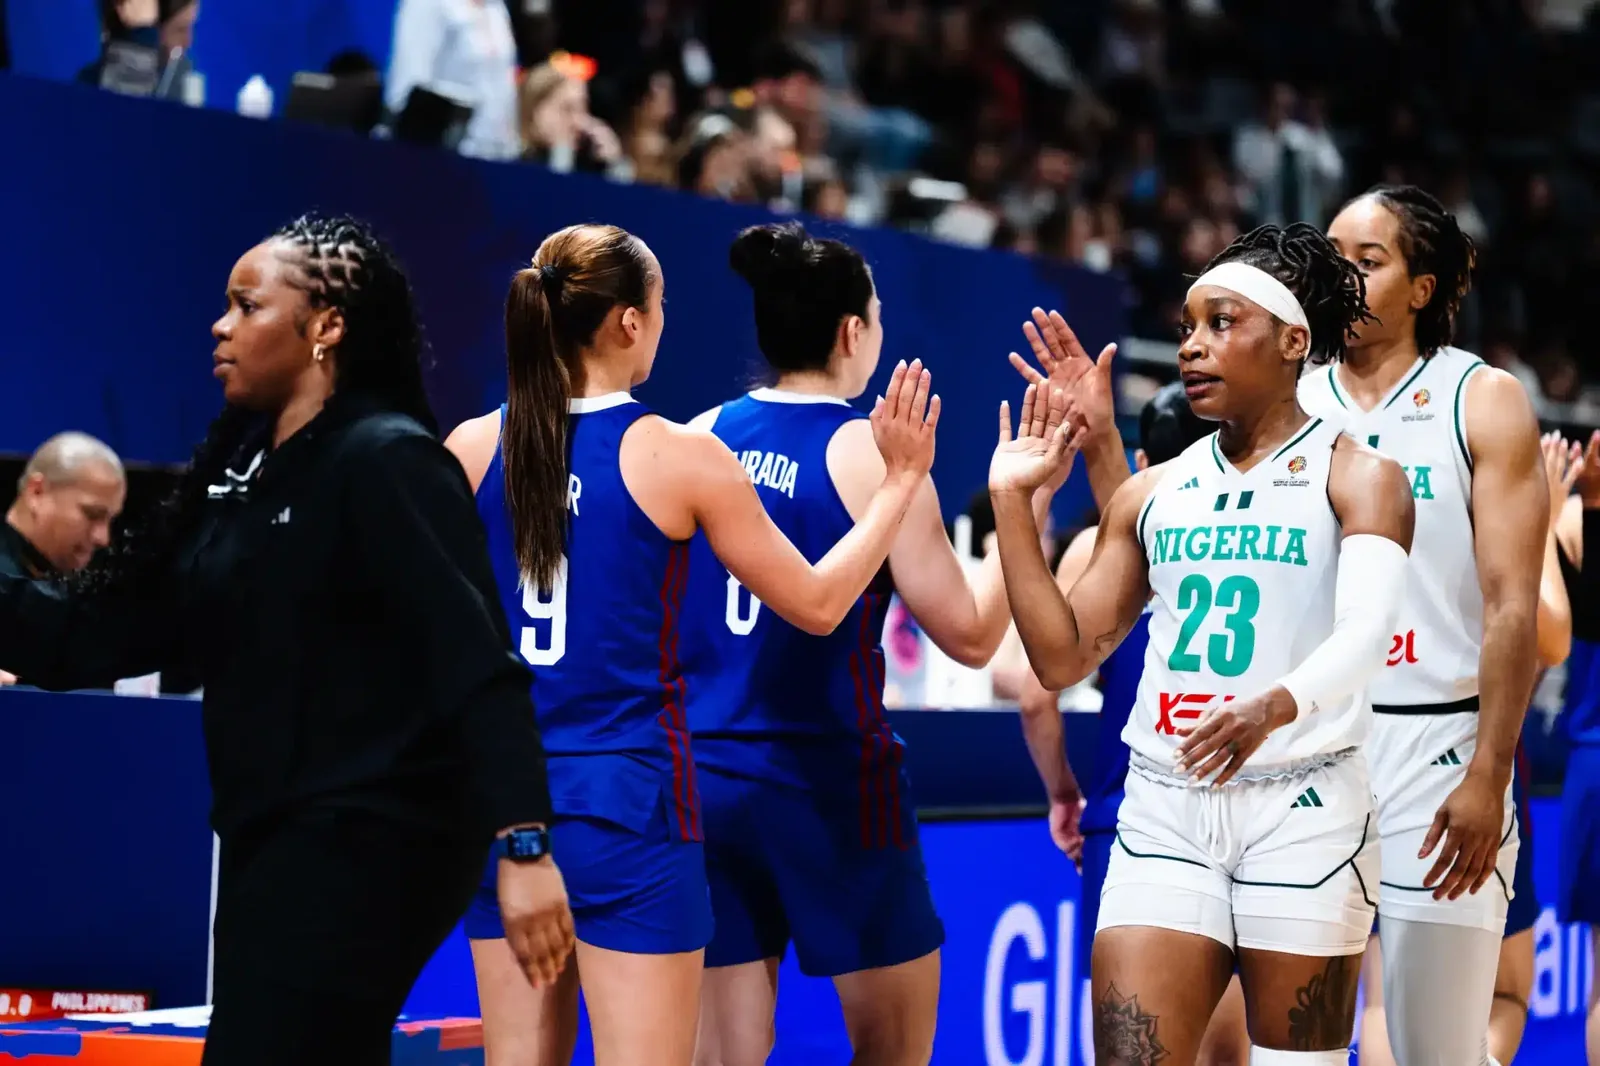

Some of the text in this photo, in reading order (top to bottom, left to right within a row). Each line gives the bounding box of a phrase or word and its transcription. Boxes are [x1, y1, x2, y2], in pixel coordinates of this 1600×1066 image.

[1152, 525, 1309, 566] NIGERIA
[520, 552, 569, 666] 9
[1167, 573, 1261, 677] 23
